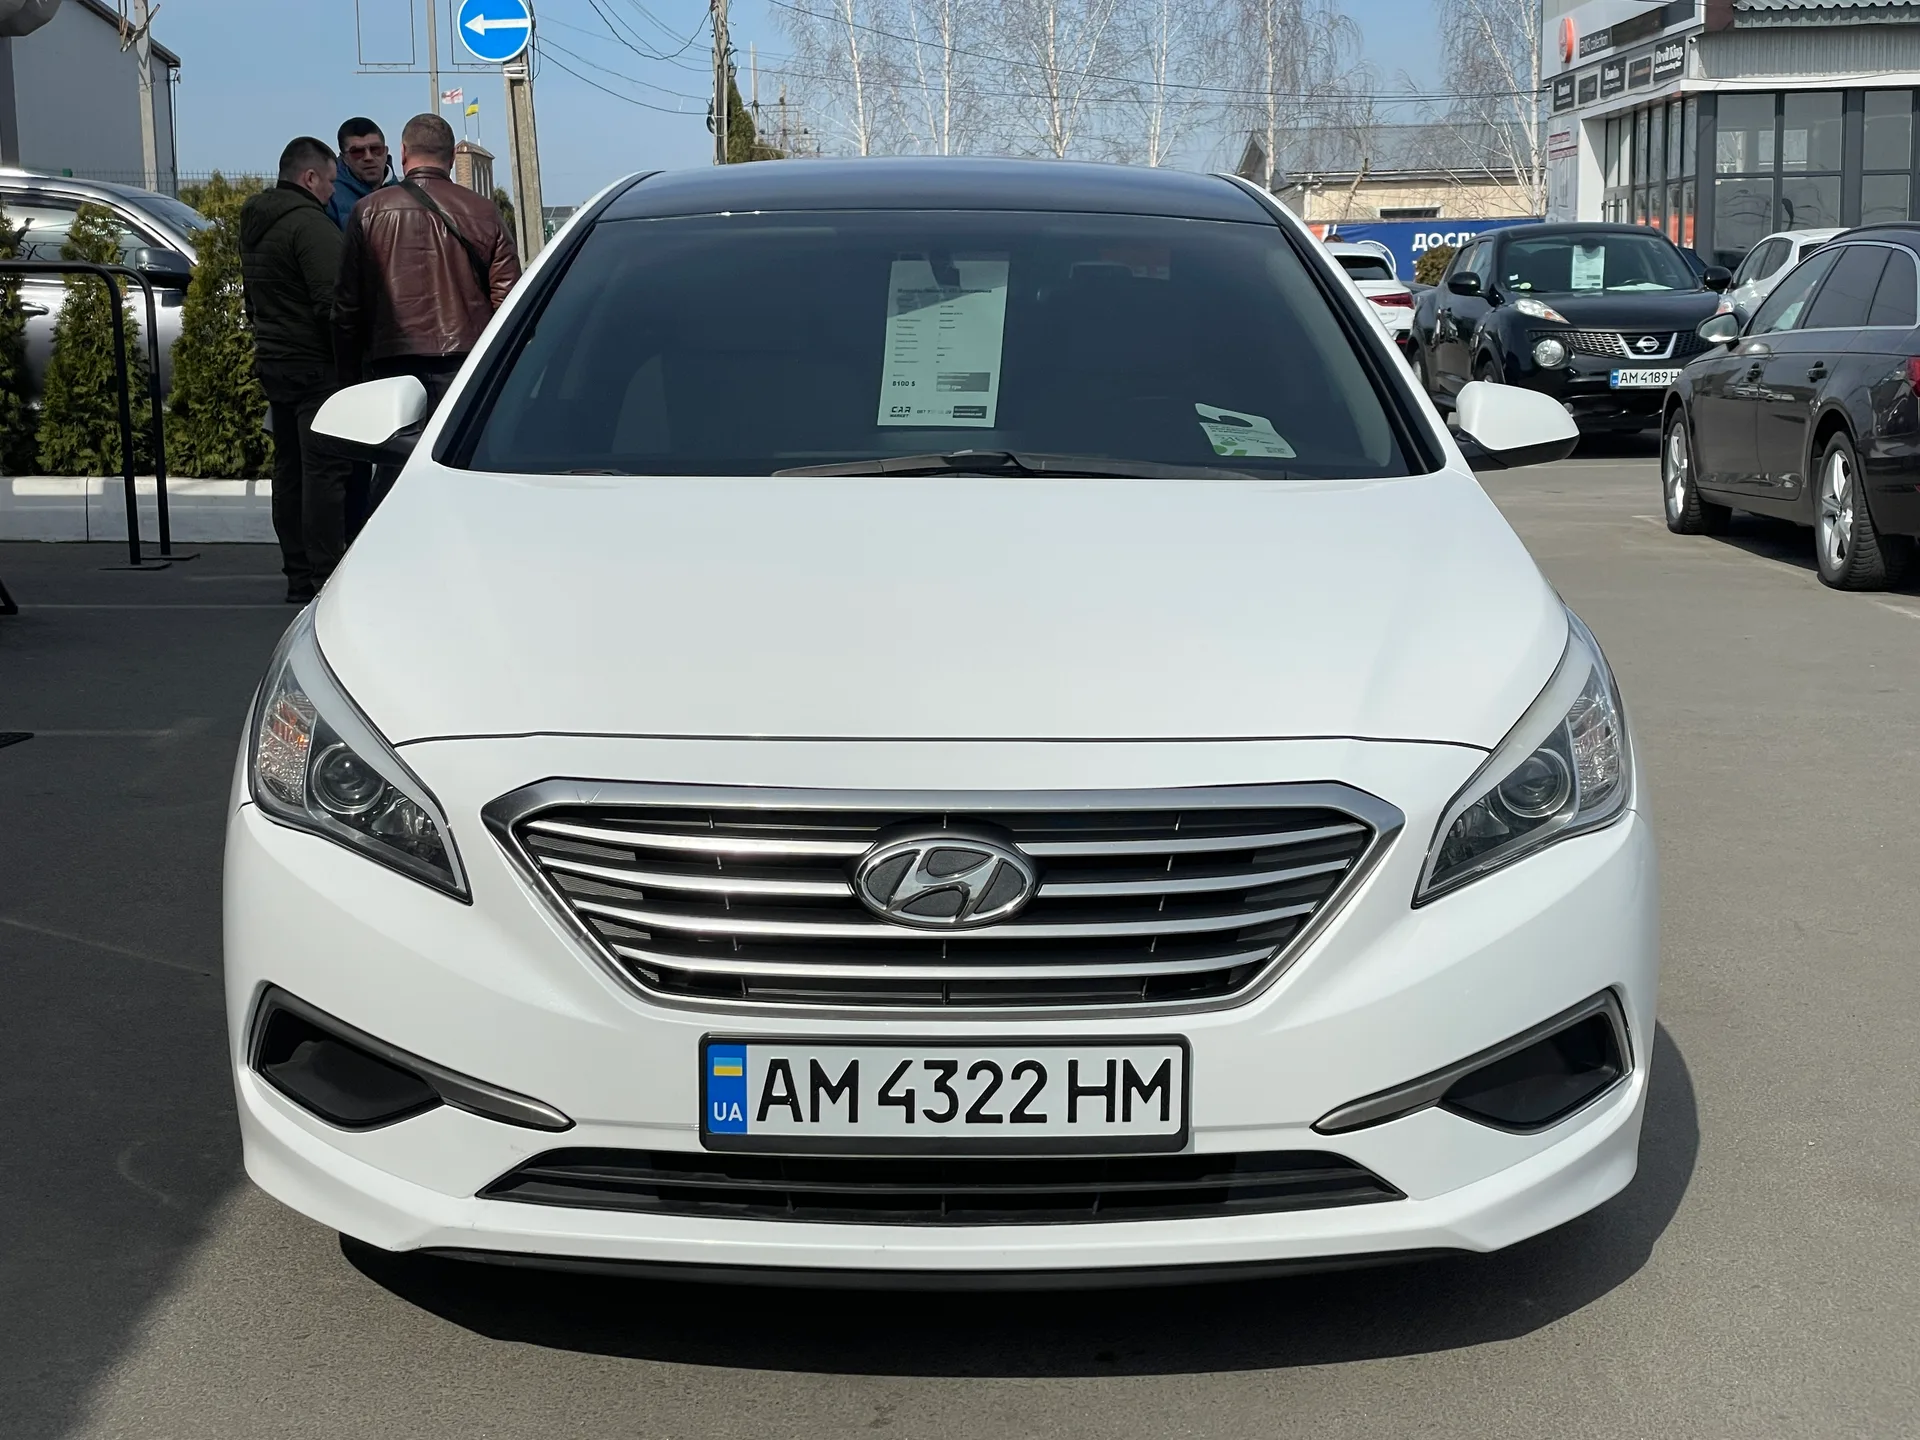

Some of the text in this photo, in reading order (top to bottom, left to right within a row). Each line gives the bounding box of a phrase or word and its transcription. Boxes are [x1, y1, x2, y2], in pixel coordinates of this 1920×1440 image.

[1412, 232, 1478, 251] ДОСЛ
[1619, 372, 1638, 384] AM
[1640, 371, 1668, 384] 4189
[756, 1057, 1171, 1124] AM 4322 HM
[713, 1101, 743, 1121] UA
